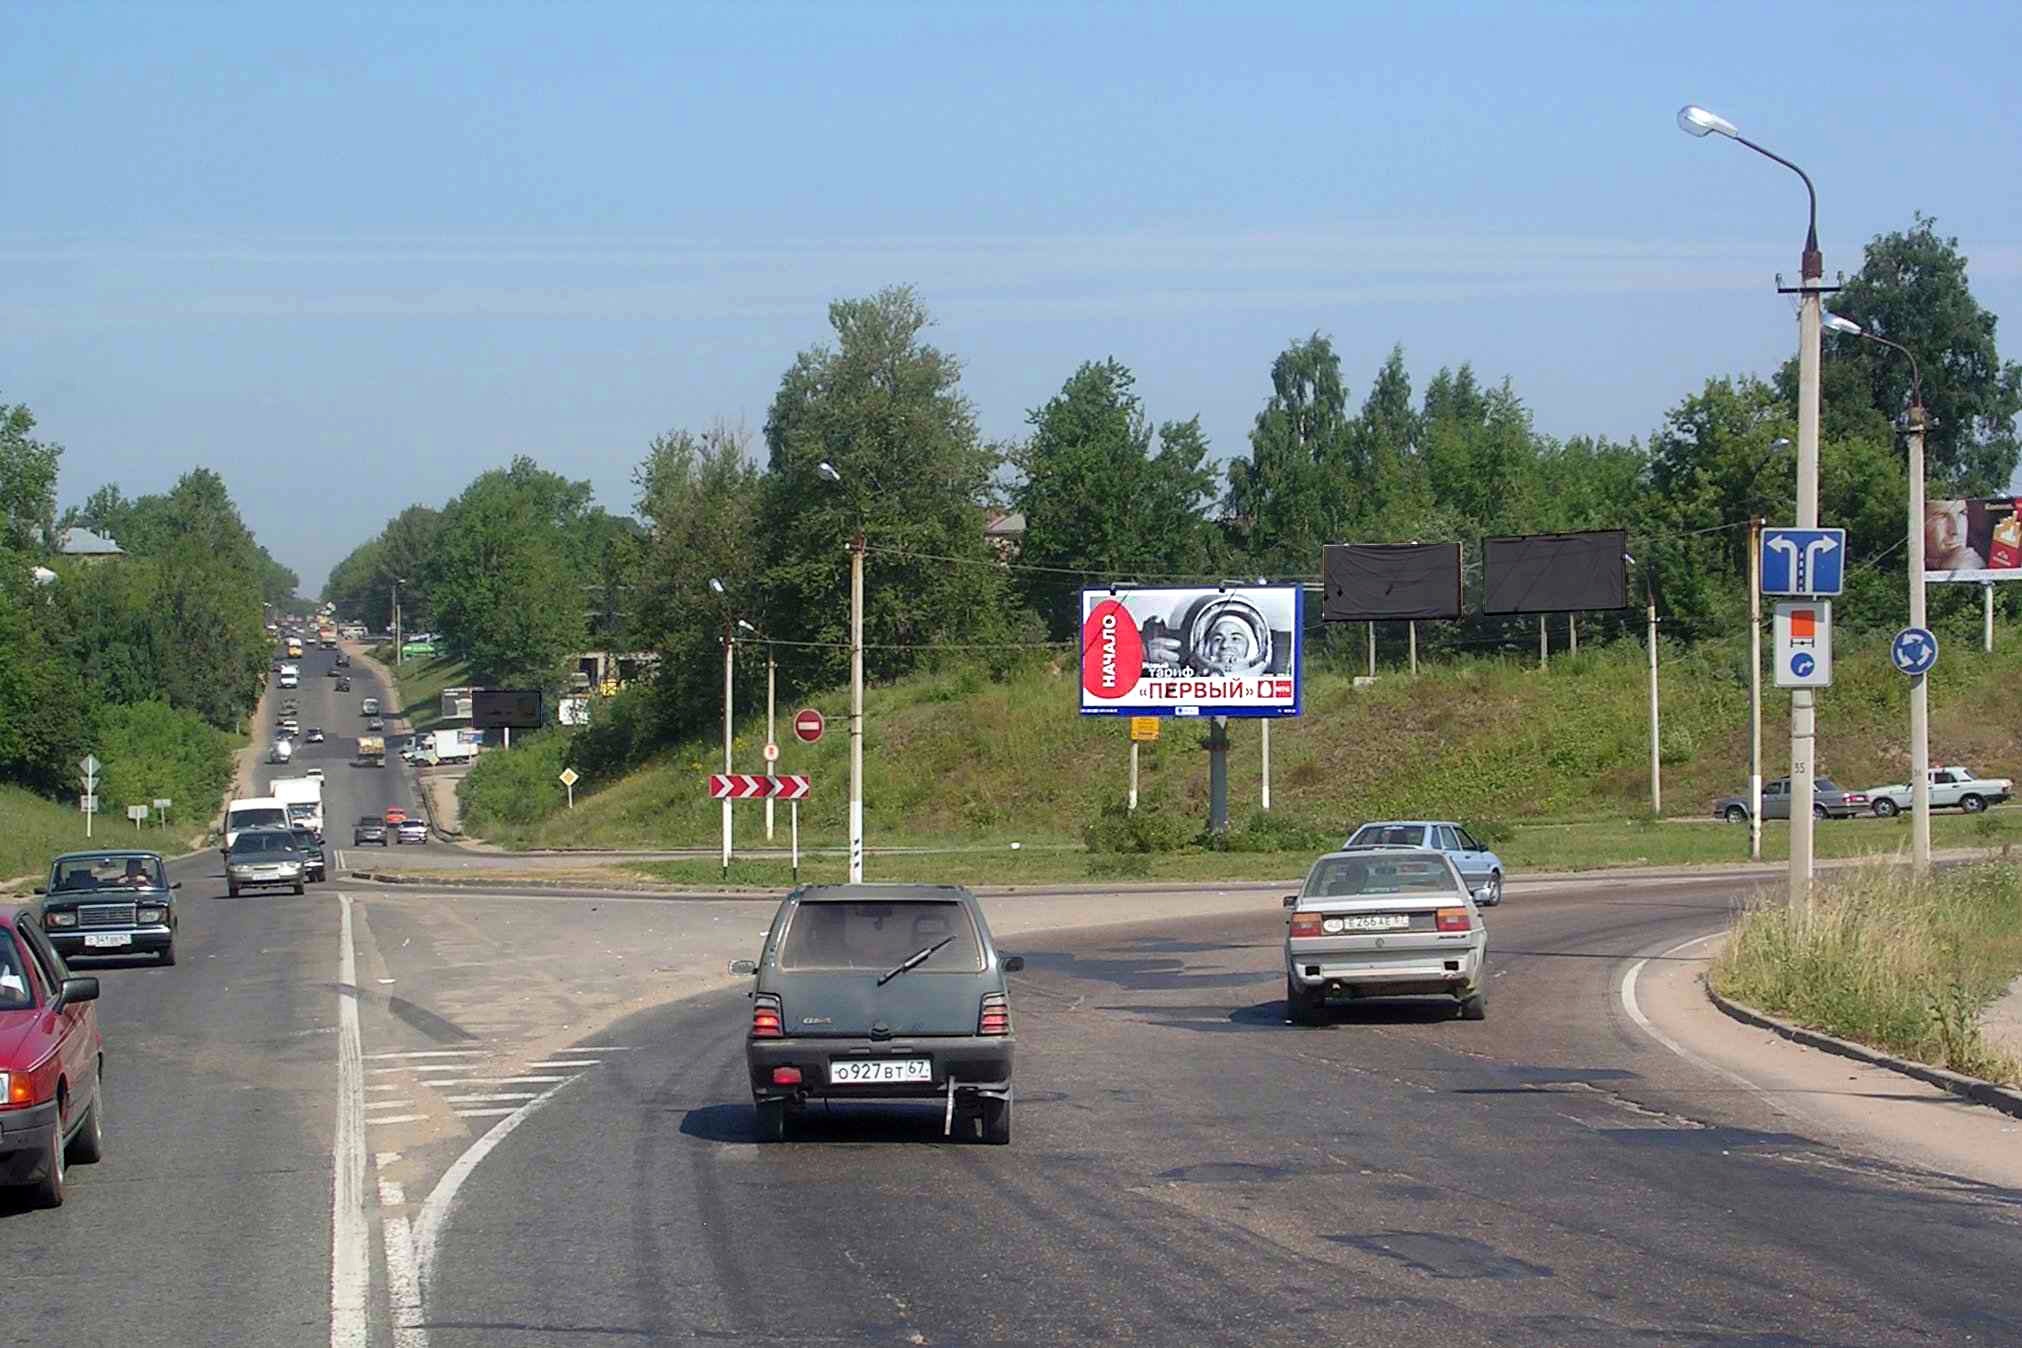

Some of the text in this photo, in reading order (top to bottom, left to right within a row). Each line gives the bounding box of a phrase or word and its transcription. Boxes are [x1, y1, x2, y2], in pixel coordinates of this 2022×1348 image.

[1102, 614, 1117, 688] НАЧАЛО
[1149, 664, 1195, 679] тариф
[1139, 678, 1254, 699] «ПЕРВЫЙ»
